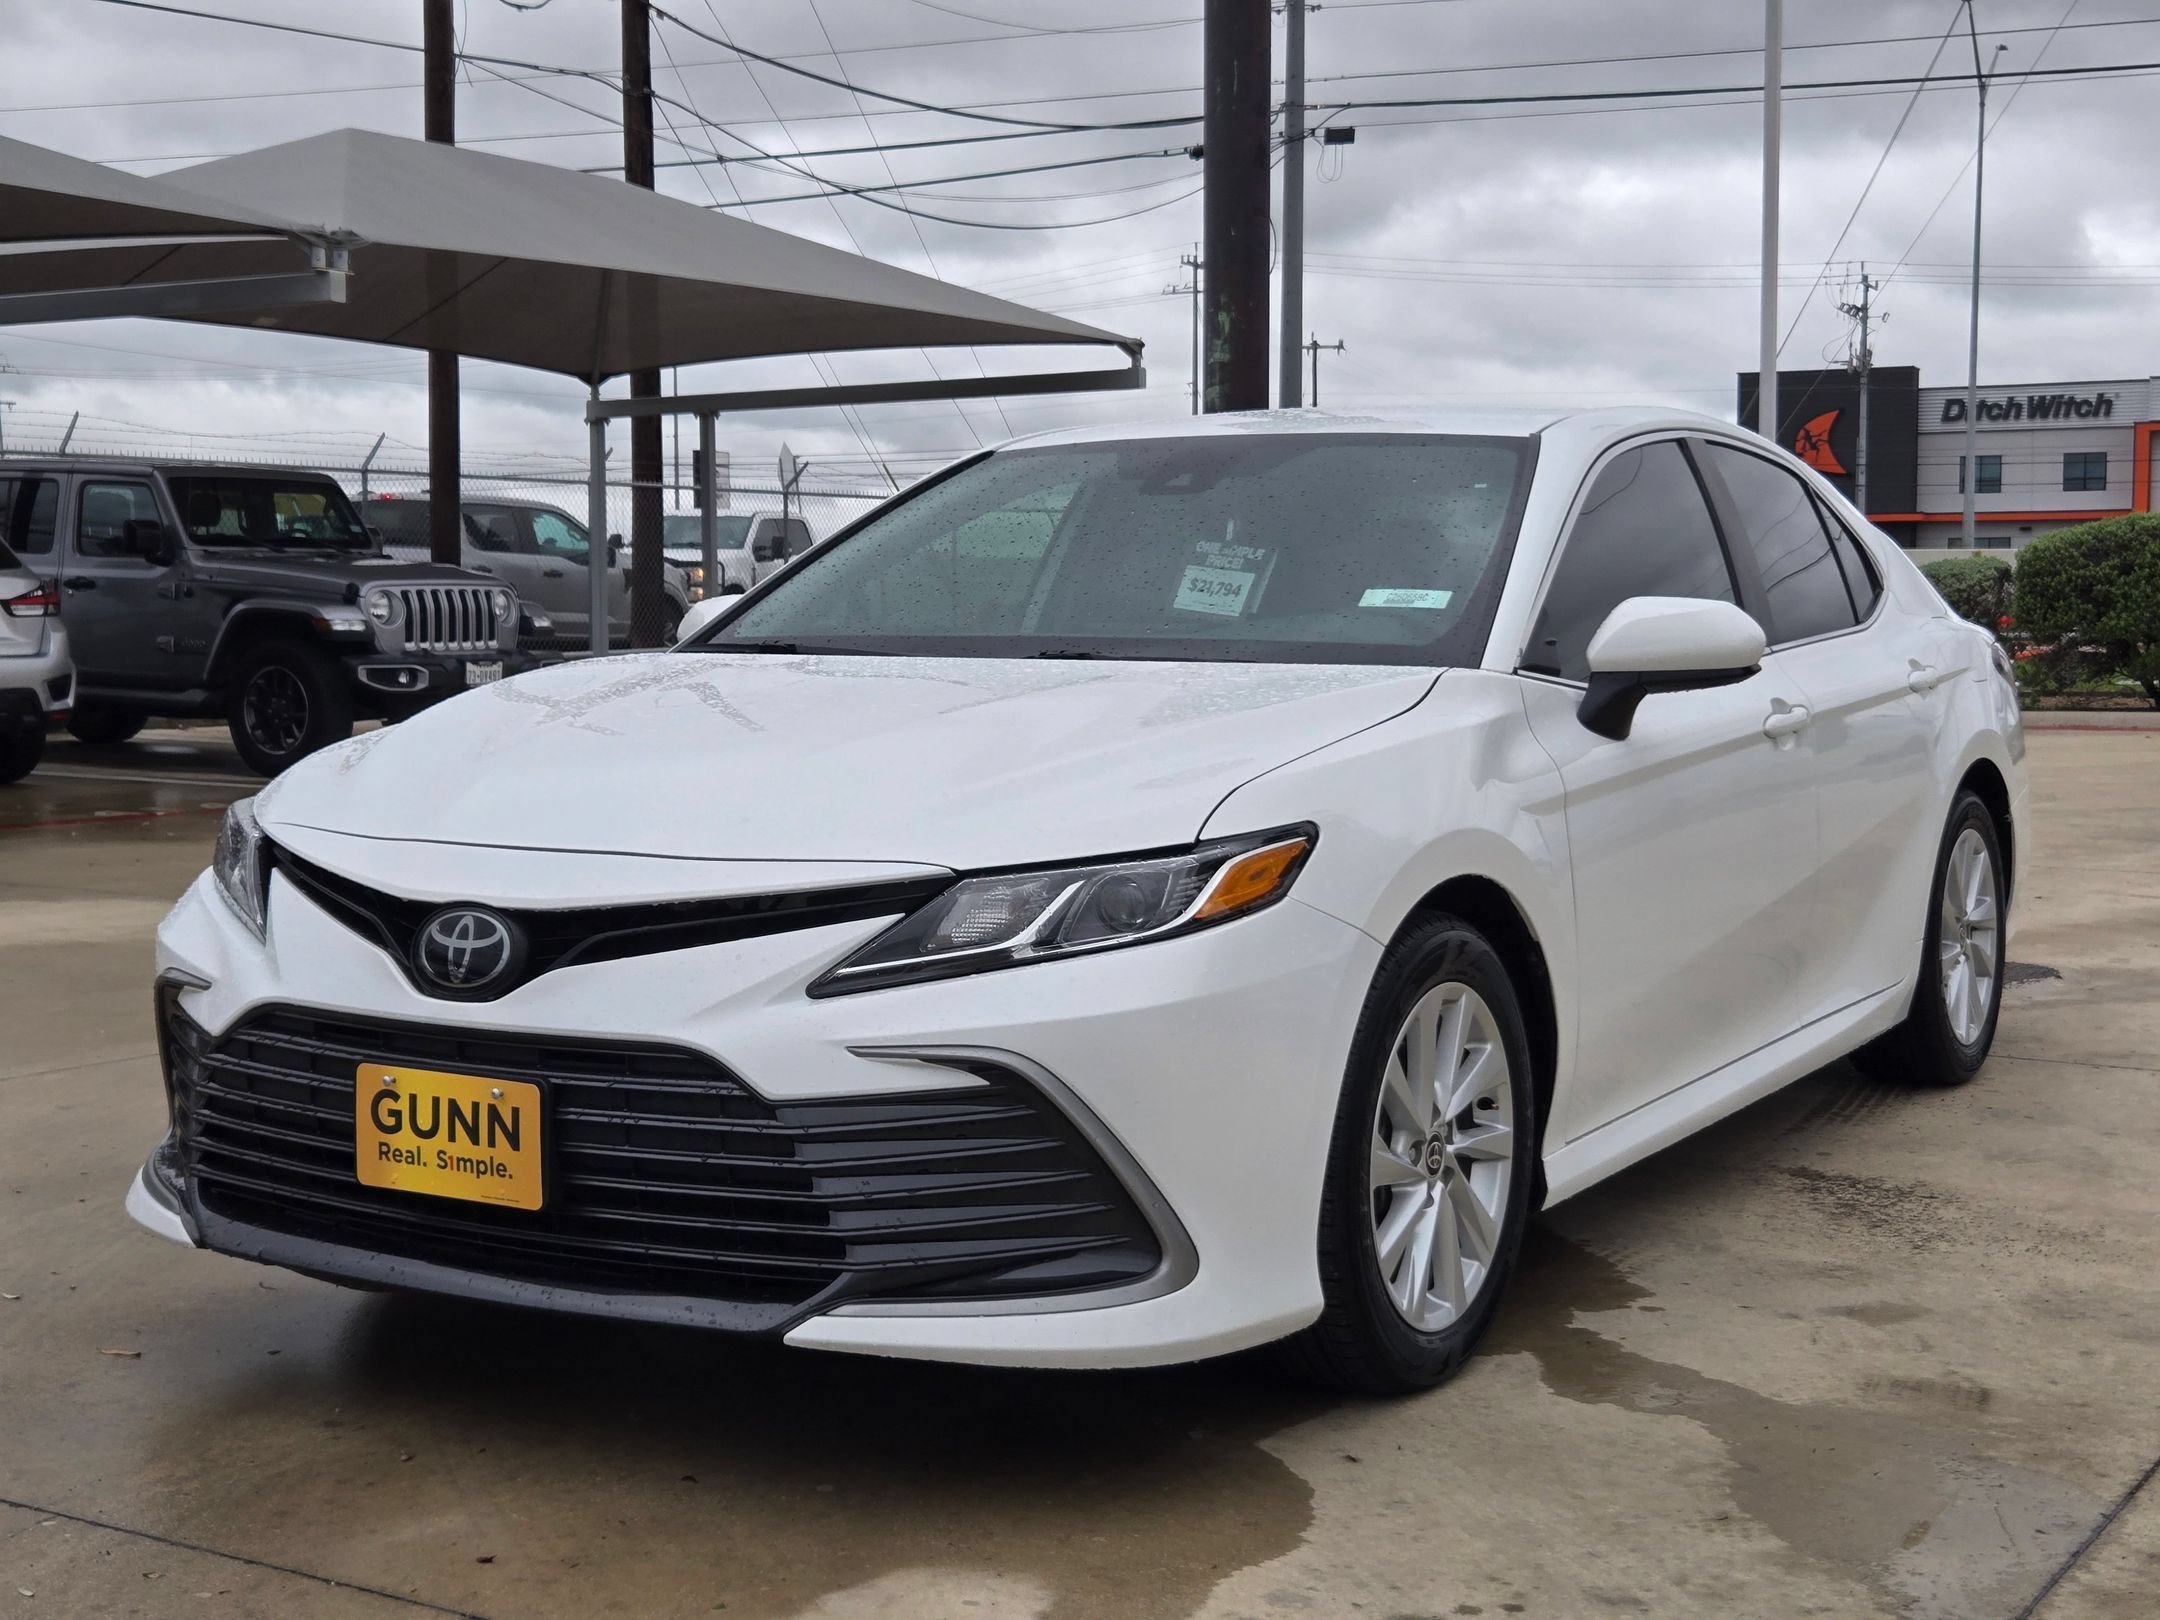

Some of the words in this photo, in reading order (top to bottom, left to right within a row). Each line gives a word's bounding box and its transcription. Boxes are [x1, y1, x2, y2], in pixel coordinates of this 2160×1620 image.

[1941, 396, 2023, 422] Dtch
[2026, 393, 2113, 419] Witch
[1196, 541, 1222, 555] ONE
[1187, 577, 1243, 597] $21,794
[371, 1089, 520, 1152] GUNN
[378, 1141, 427, 1167] Real.
